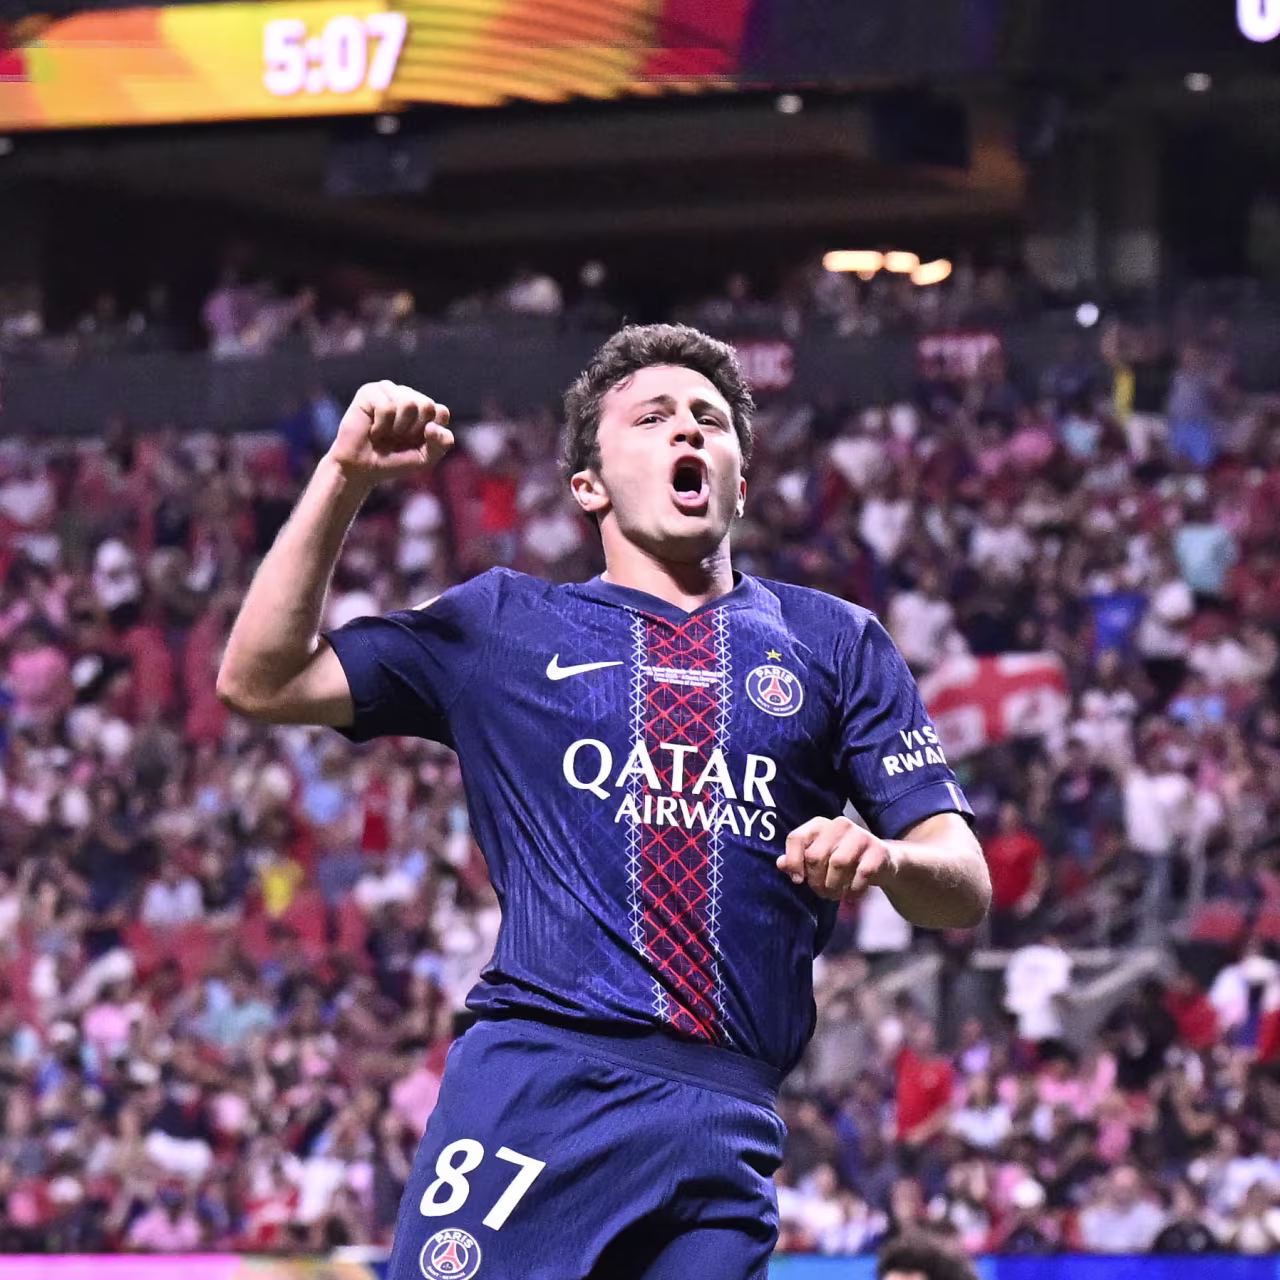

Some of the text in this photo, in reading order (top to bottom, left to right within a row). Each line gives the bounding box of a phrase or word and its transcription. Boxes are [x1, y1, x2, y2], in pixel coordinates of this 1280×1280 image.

[263, 14, 408, 96] 5:07
[562, 738, 778, 808] QATAR
[614, 793, 778, 842] AIRWAYS
[420, 1138, 547, 1231] 87
[434, 1231, 475, 1250] PARIS
